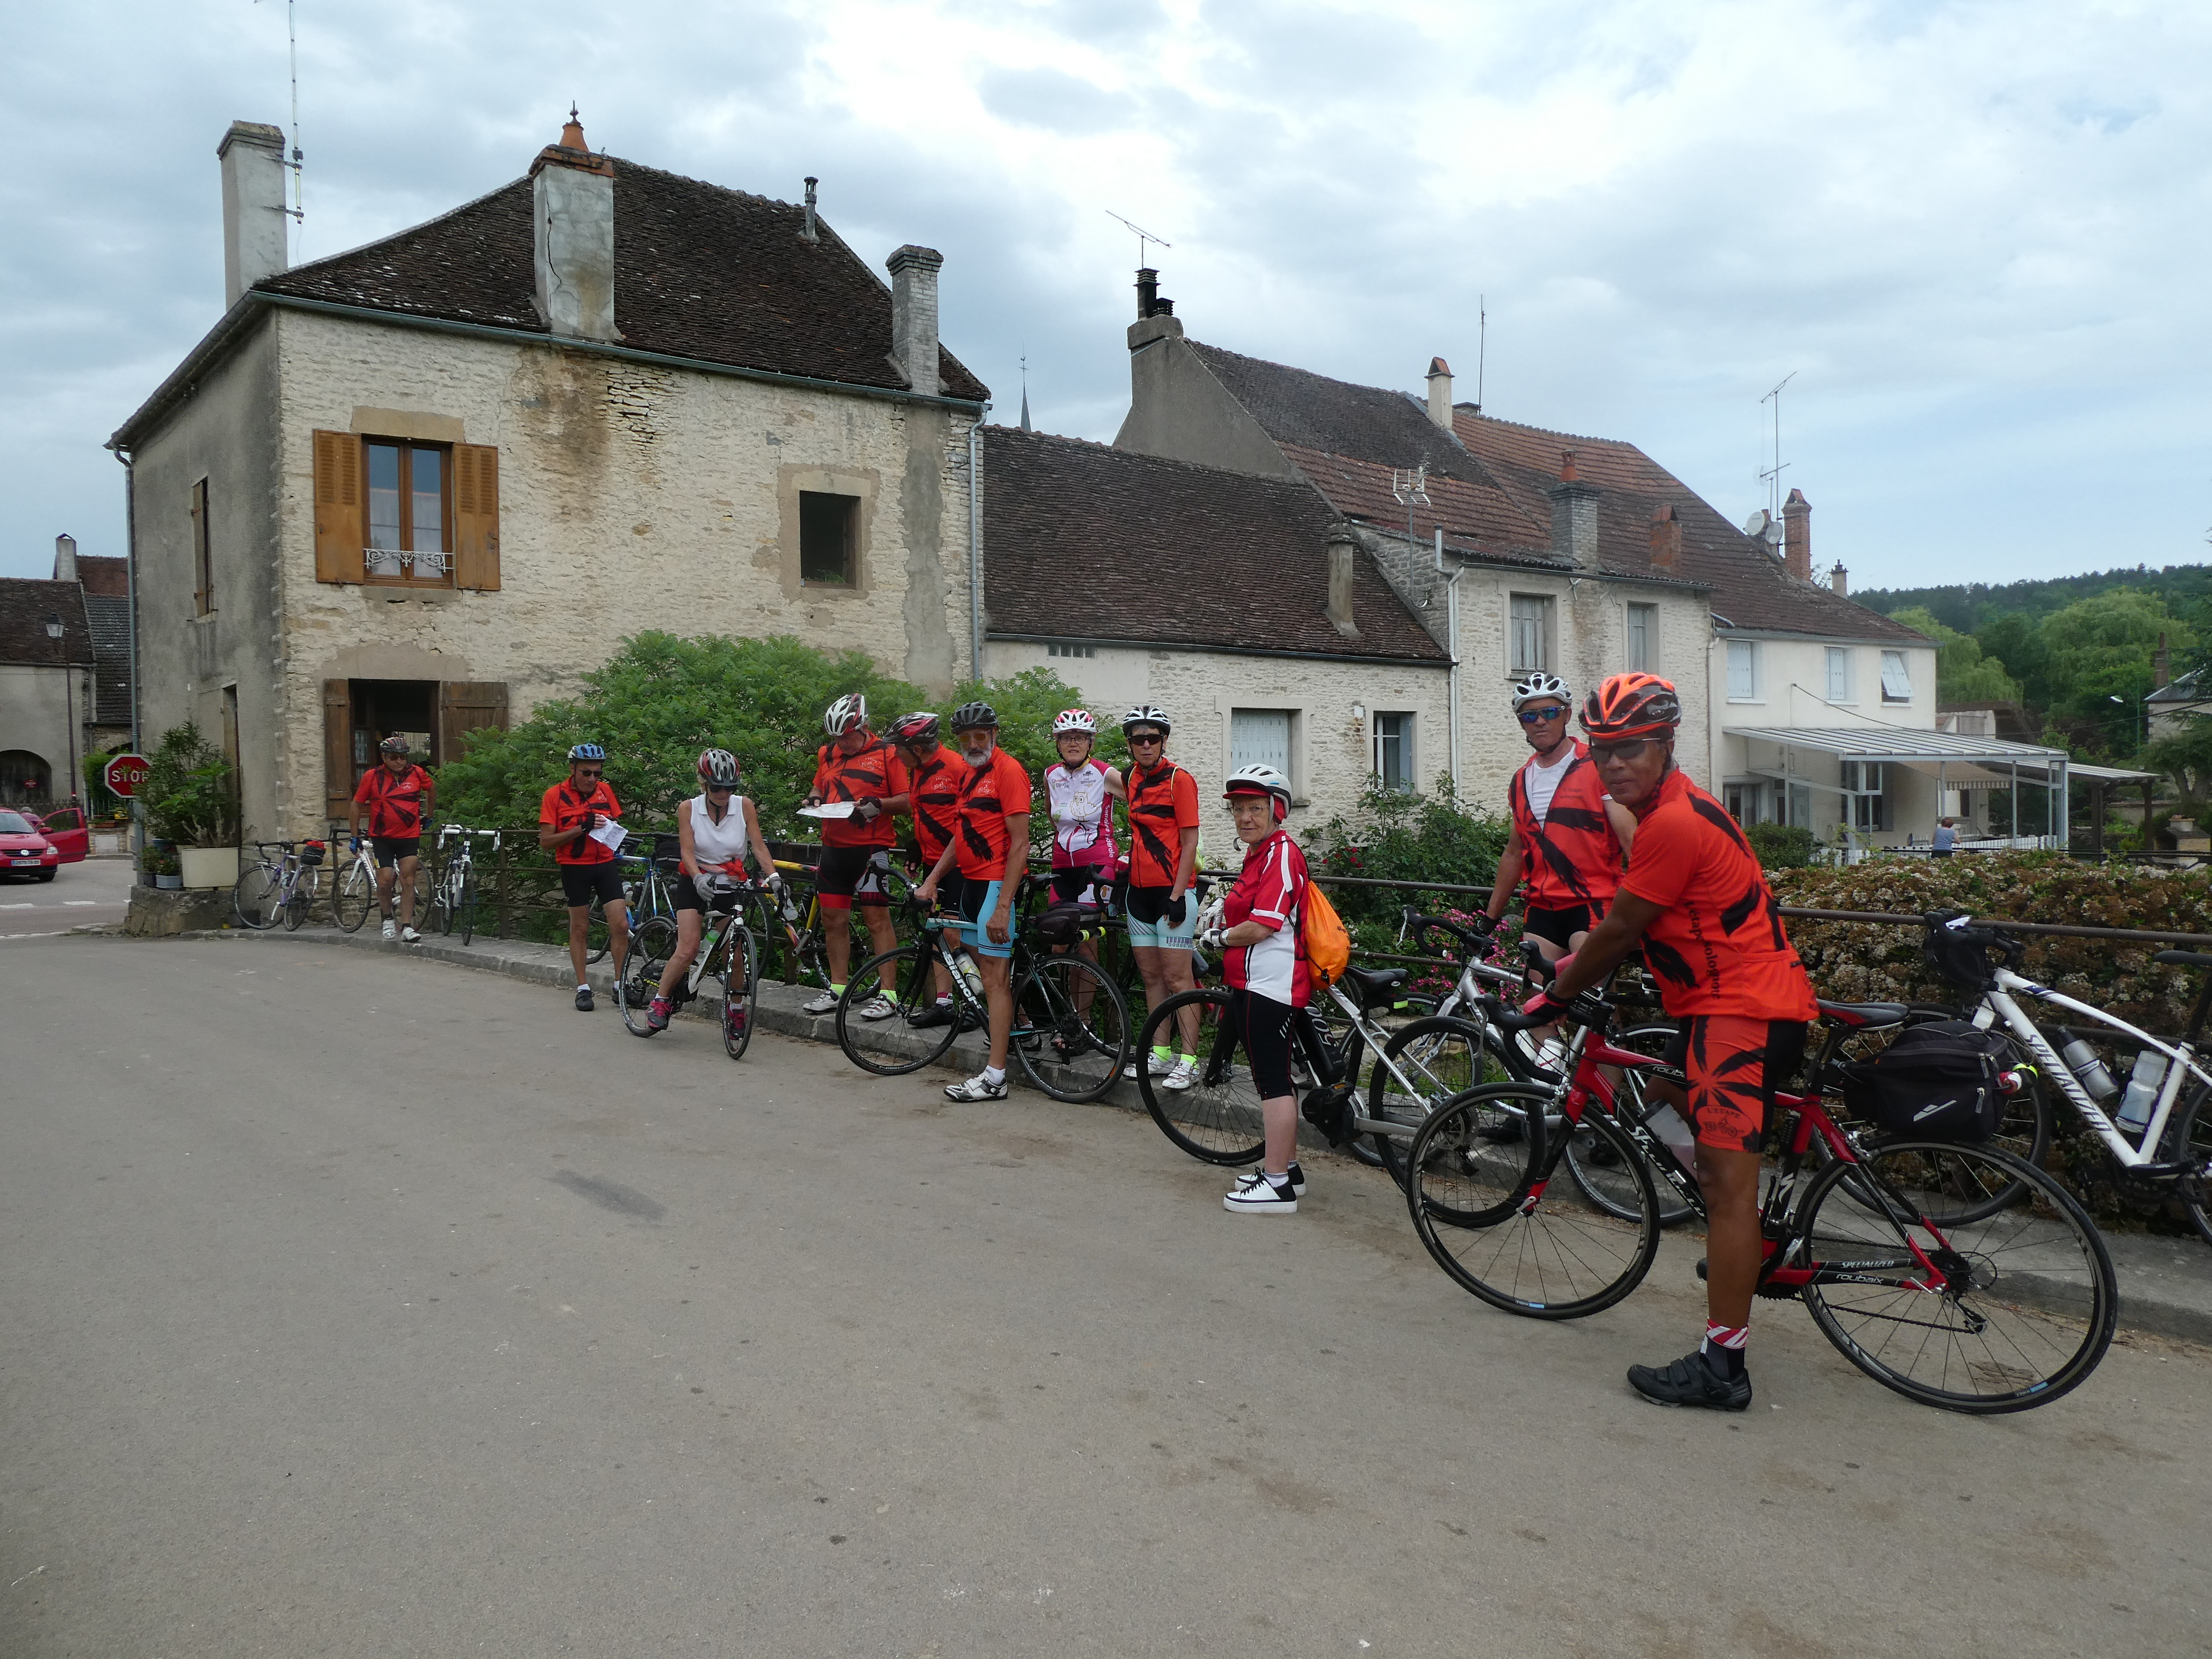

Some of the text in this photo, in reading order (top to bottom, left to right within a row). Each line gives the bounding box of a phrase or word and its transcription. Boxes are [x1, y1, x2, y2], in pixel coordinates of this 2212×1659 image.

[111, 770, 148, 782] STOP
[1304, 1006, 1337, 1048] 500
[2025, 1034, 2113, 1132] SPECIALIZED
[1840, 1260, 1895, 1269] SPECIALIZED
[1836, 1274, 1884, 1285] roubaix
